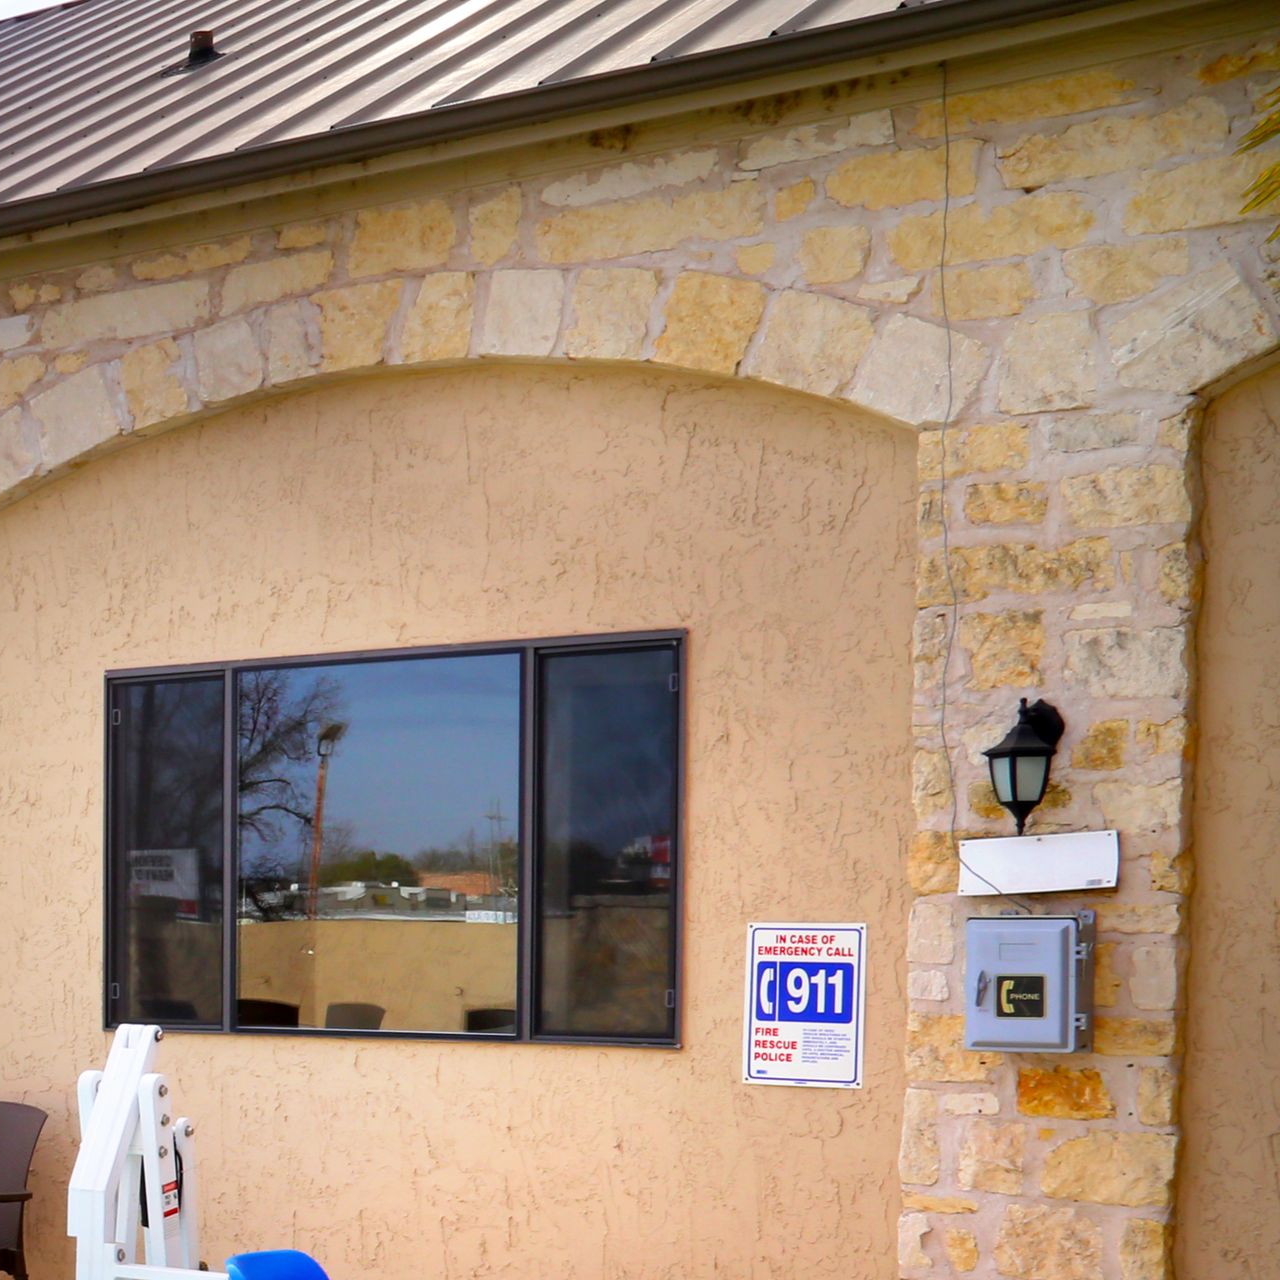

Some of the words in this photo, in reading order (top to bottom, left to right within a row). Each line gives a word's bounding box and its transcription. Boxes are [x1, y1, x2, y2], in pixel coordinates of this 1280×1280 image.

[775, 934, 787, 944] IN
[790, 934, 819, 945] CASE
[821, 935, 836, 945] OF
[757, 946, 823, 957] EMERGENCY
[826, 947, 854, 957] CALL
[786, 967, 844, 1014] 911
[755, 1027, 779, 1037] FIRE
[754, 1039, 798, 1050] RESCUE
[754, 1052, 793, 1062] POLICE
